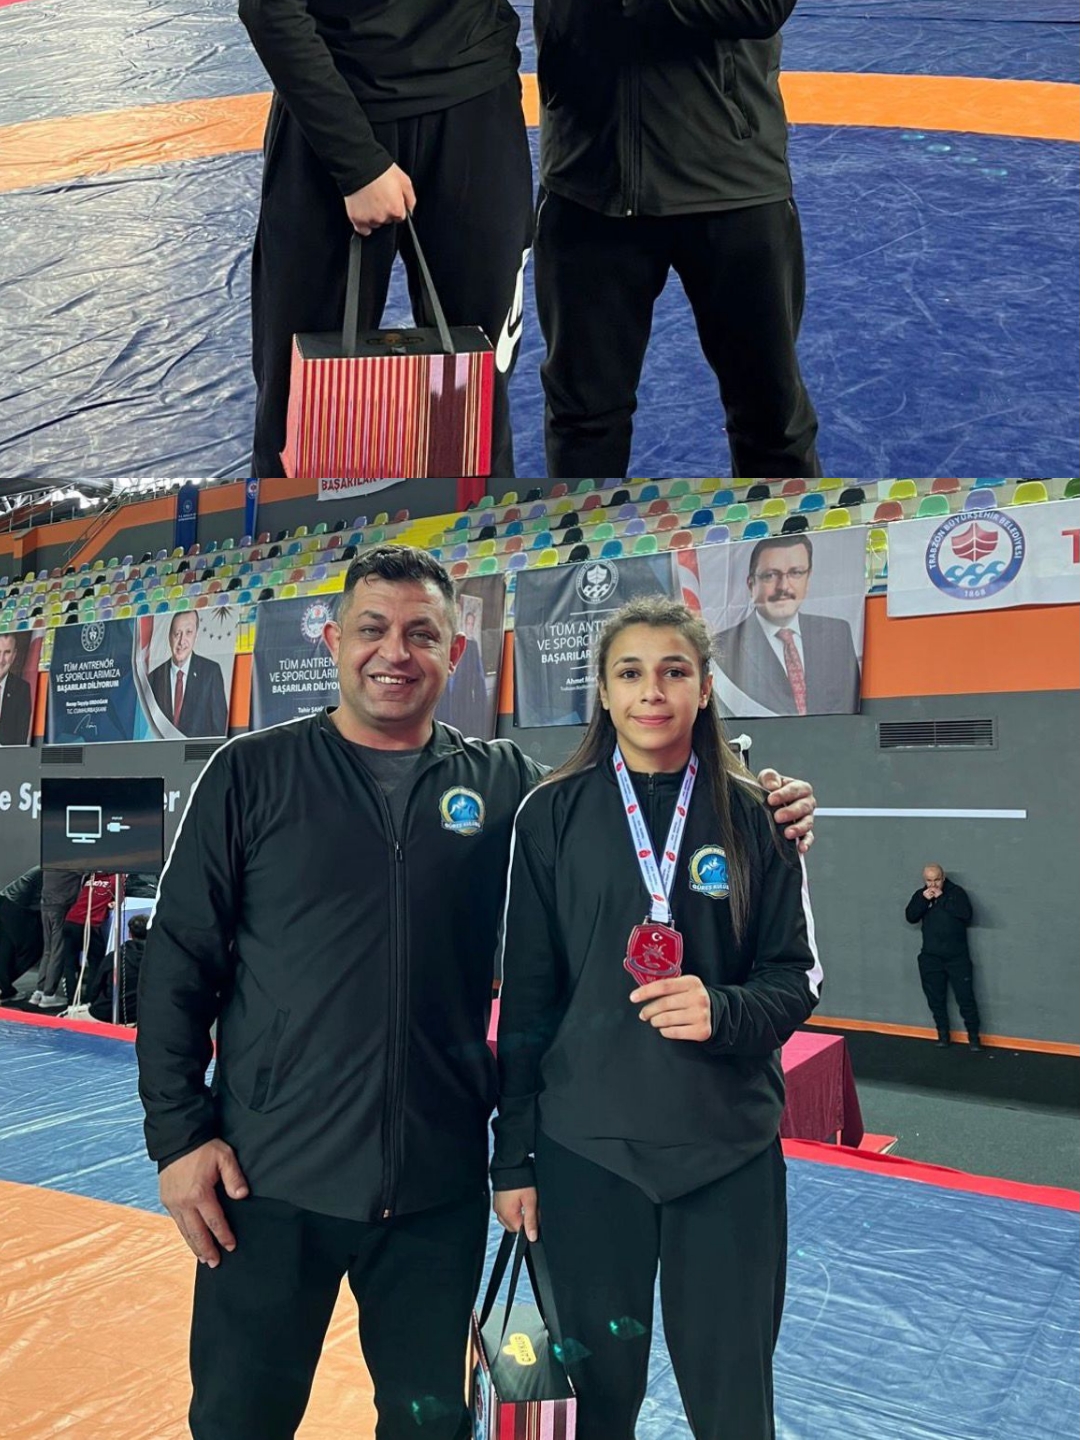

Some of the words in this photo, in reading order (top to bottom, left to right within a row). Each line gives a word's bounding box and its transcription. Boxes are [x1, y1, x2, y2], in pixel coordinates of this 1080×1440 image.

[929, 530, 946, 570] TRABZON
[964, 588, 986, 598] 1868
[550, 622, 576, 637] TÜM
[537, 639, 551, 650] VE
[279, 658, 299, 671] TÜM
[300, 656, 336, 669] ANTREN
[269, 671, 280, 683] VE
[272, 683, 312, 695] BAŞARILAR
